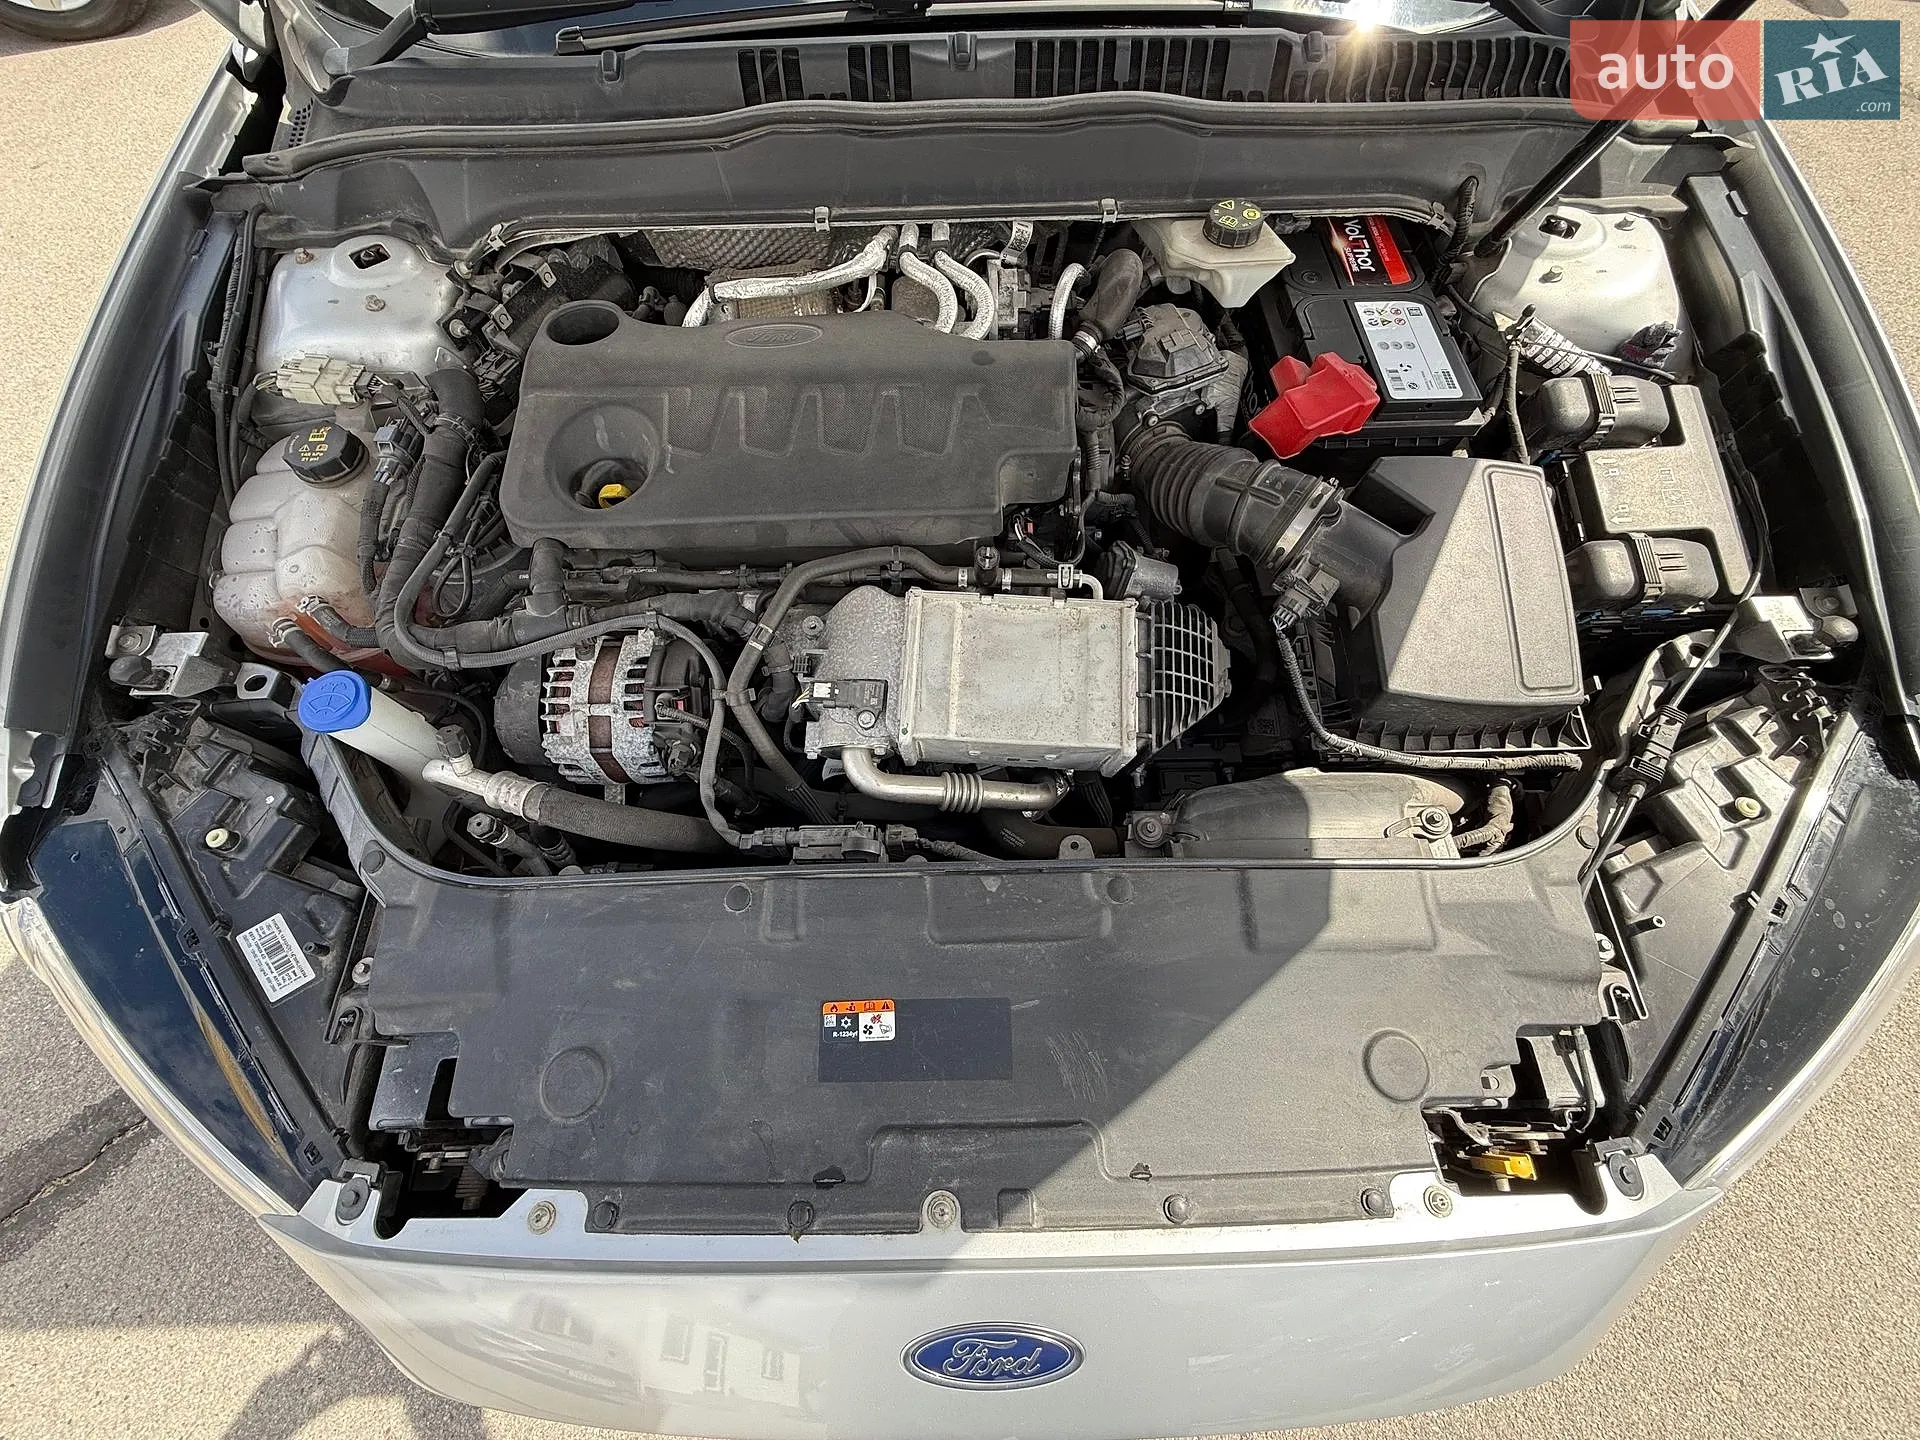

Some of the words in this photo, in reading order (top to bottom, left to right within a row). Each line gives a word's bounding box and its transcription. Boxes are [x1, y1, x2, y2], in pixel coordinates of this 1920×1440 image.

[1344, 247, 1360, 273] SUPREME
[746, 327, 800, 344] Ford
[832, 1030, 858, 1038] R-1234yf
[943, 1338, 1043, 1377] Ford
